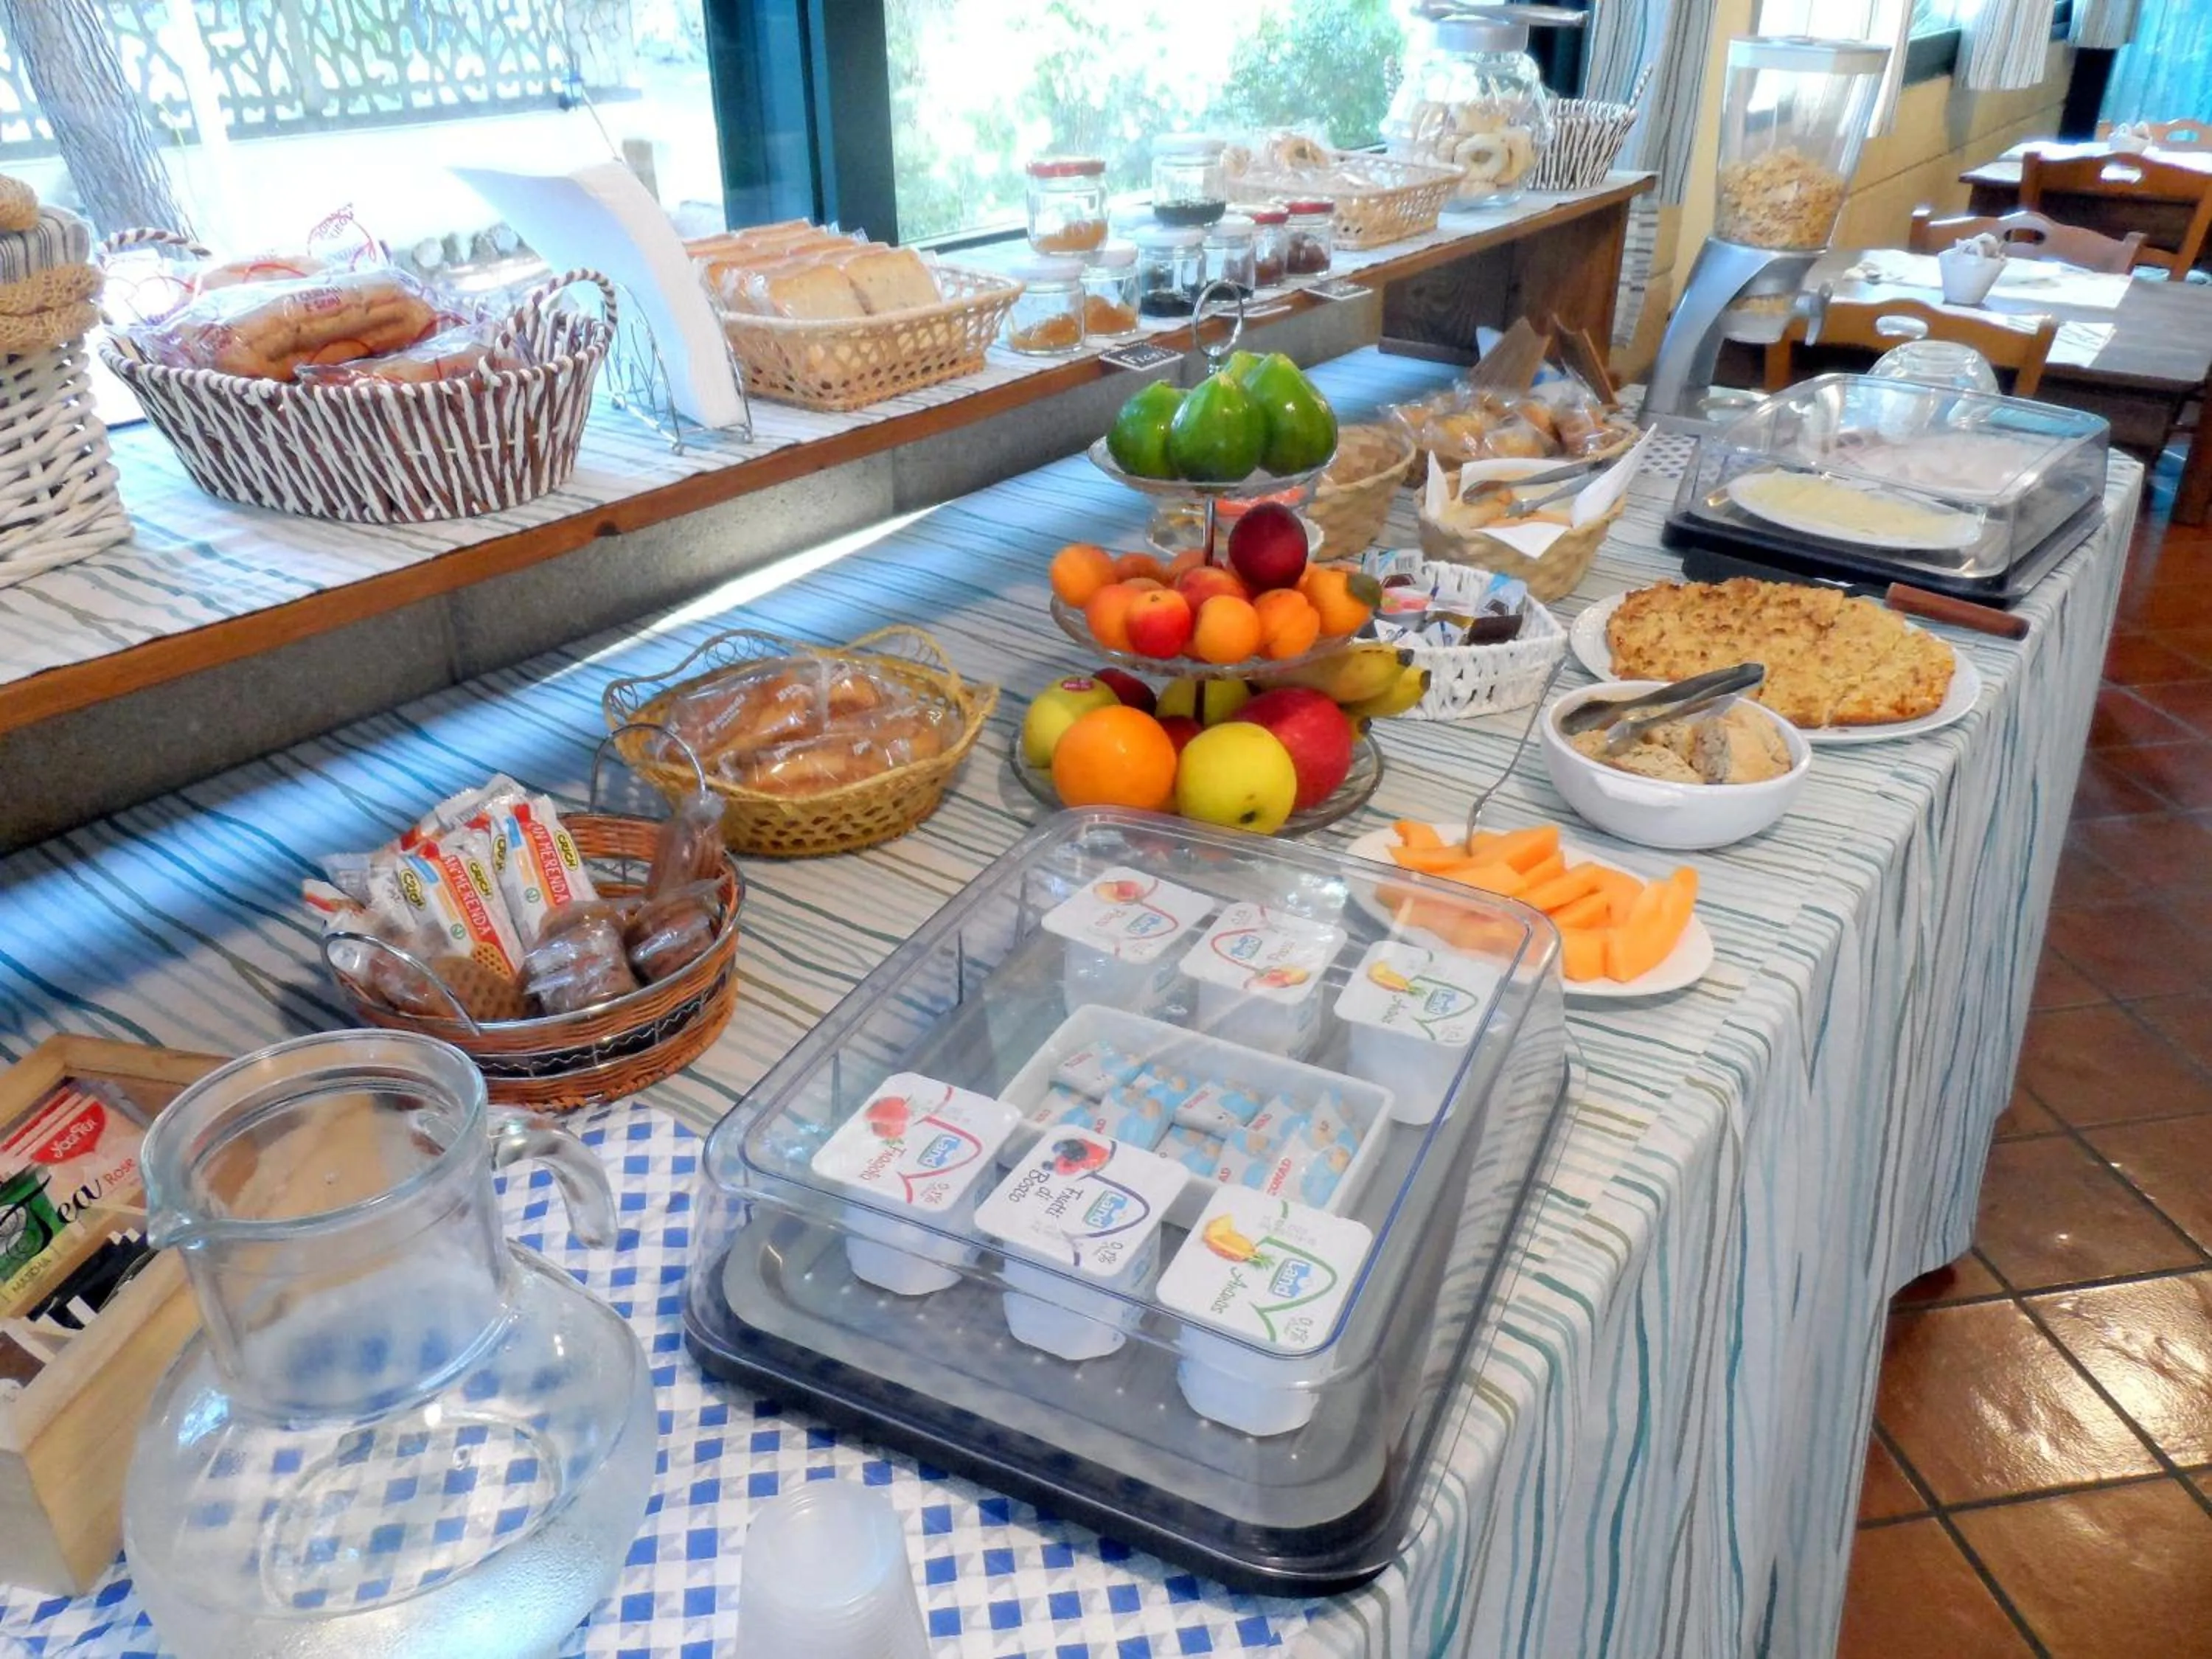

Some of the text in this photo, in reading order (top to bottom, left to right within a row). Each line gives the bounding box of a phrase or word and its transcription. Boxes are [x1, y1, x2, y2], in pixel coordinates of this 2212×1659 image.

[557, 834, 577, 867] CRICH
[860, 1144, 908, 1181] Fragola
[923, 1135, 958, 1167] Land
[1008, 1169, 1050, 1203] Bosco
[1034, 1186, 1052, 1202] di
[1045, 1188, 1084, 1218] Frutti
[1088, 1192, 1127, 1228] Land
[1210, 1267, 1248, 1315] Ananas
[1274, 1260, 1306, 1297] Land
